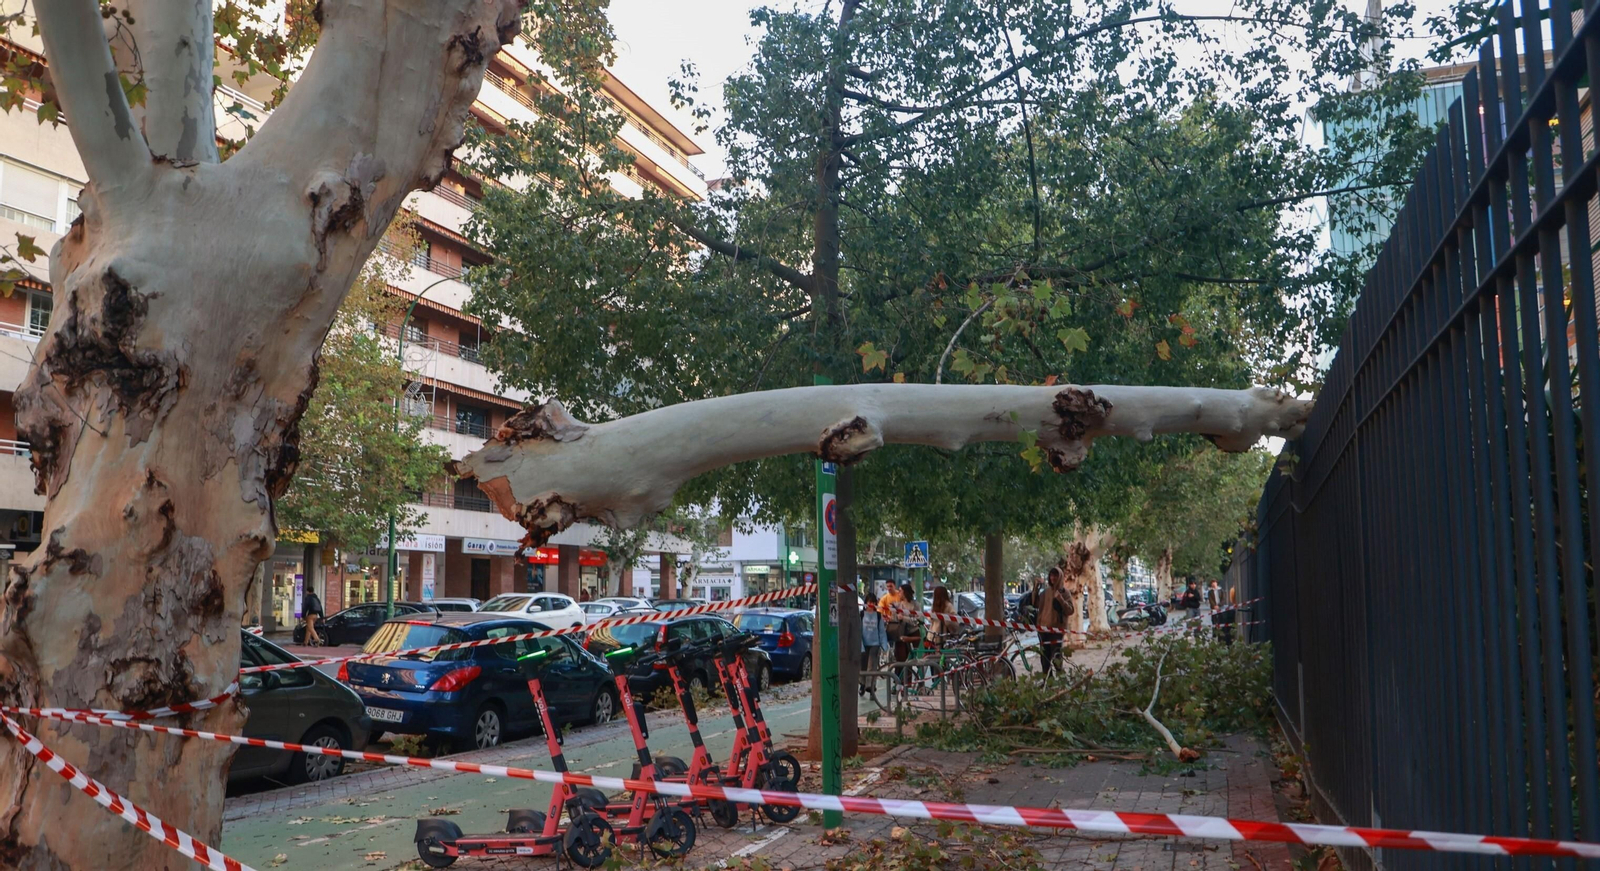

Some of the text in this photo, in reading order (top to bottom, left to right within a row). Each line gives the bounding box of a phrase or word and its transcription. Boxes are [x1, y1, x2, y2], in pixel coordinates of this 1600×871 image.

[467, 542, 485, 550] Garay
[694, 577, 726, 585] ARMACIA
[367, 707, 402, 721] 9068 GHJ
